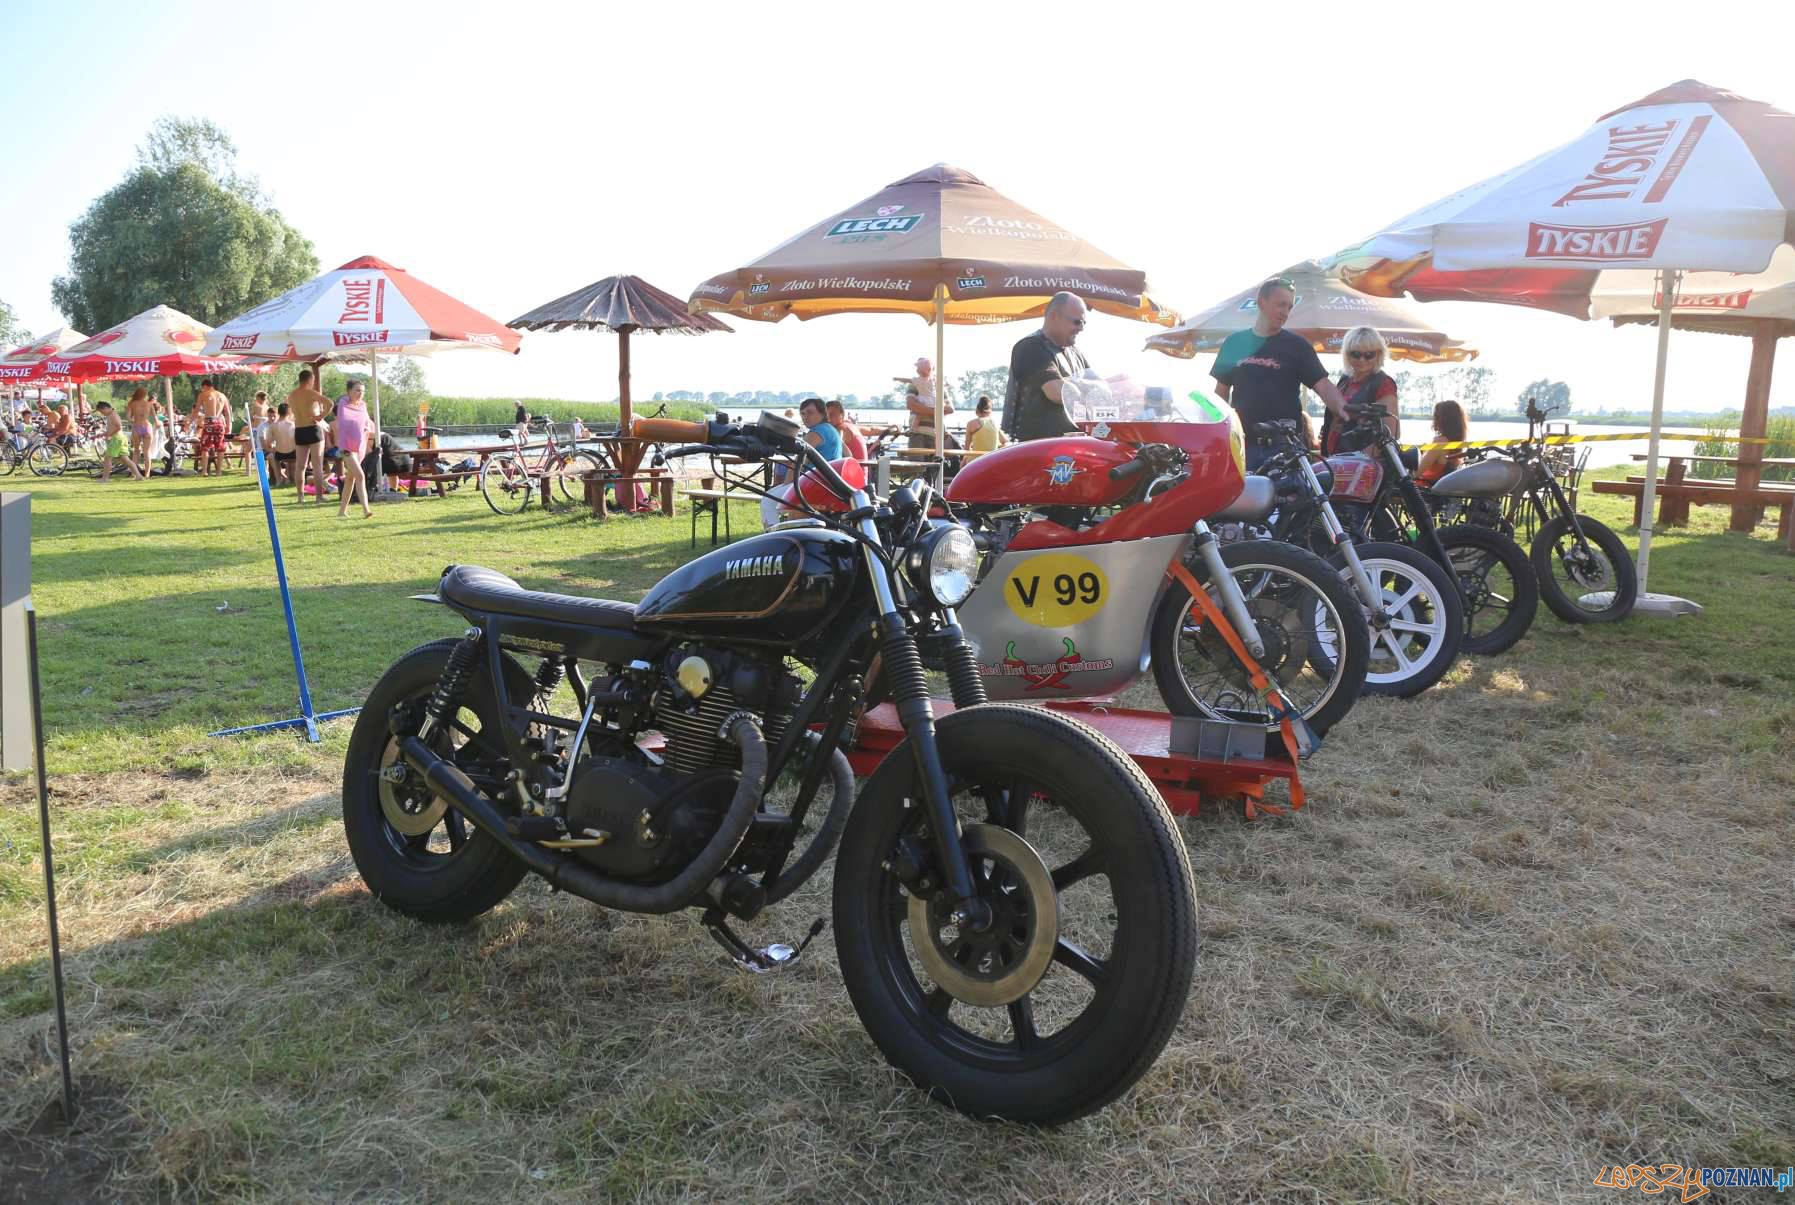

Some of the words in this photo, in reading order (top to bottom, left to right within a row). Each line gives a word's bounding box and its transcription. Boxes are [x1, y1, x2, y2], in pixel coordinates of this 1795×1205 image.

[1552, 119, 1678, 207] TYSKIE
[836, 217, 911, 233] LECH
[1536, 225, 1655, 256] TYSKIE
[780, 279, 816, 292] Złoto
[818, 277, 912, 292] Wielkopolski
[959, 278, 984, 288] LECH
[1003, 276, 1042, 289] Złoto
[1043, 276, 1128, 297] Wielkopolski
[338, 279, 371, 325] TYSKIE
[224, 336, 257, 349] TYSKIE
[337, 332, 386, 344] TYSKIE
[0, 367, 33, 378] YSKIE
[104, 360, 160, 373] TYSKIE
[726, 555, 784, 580] YAMAHA
[1012, 575, 1041, 608] V
[1053, 571, 1101, 606] 99
[977, 663, 1001, 676] Red
[1002, 663, 1026, 676] Hot
[1059, 658, 1114, 673] Customs
